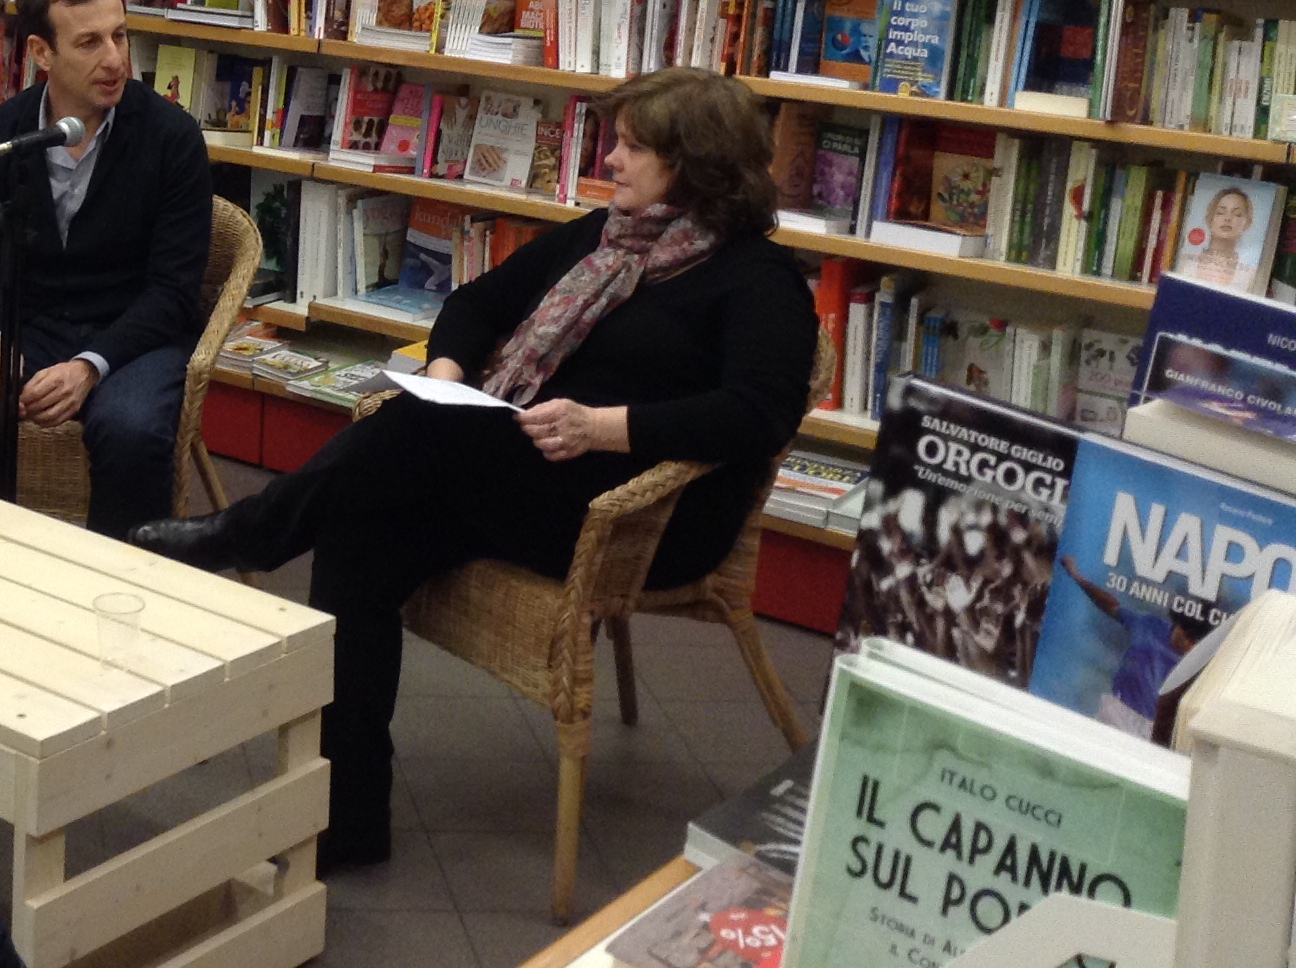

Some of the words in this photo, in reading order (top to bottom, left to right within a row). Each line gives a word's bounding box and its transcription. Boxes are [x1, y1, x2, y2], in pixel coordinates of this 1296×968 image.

[890, 15, 928, 30] corpo
[892, 0, 902, 11] Il
[905, 1, 928, 14] tuo
[885, 42, 929, 59] Acqua
[888, 28, 940, 46] implora
[1165, 369, 1245, 401] GIANFRANCO
[1247, 394, 1296, 416] CIVOLA
[921, 415, 1009, 454] SALVATORE
[1010, 444, 1066, 473] GIGLIO
[917, 434, 1070, 506] ORGOGL
[1106, 572, 1127, 592] 30
[1129, 576, 1169, 607] ANNI
[1172, 594, 1206, 622] COL
[938, 766, 998, 802] ITALO
[1005, 793, 1064, 828] CUCCI
[855, 773, 887, 829] IL
[909, 801, 1133, 907] CAPANNO
[845, 834, 919, 905] SUL
